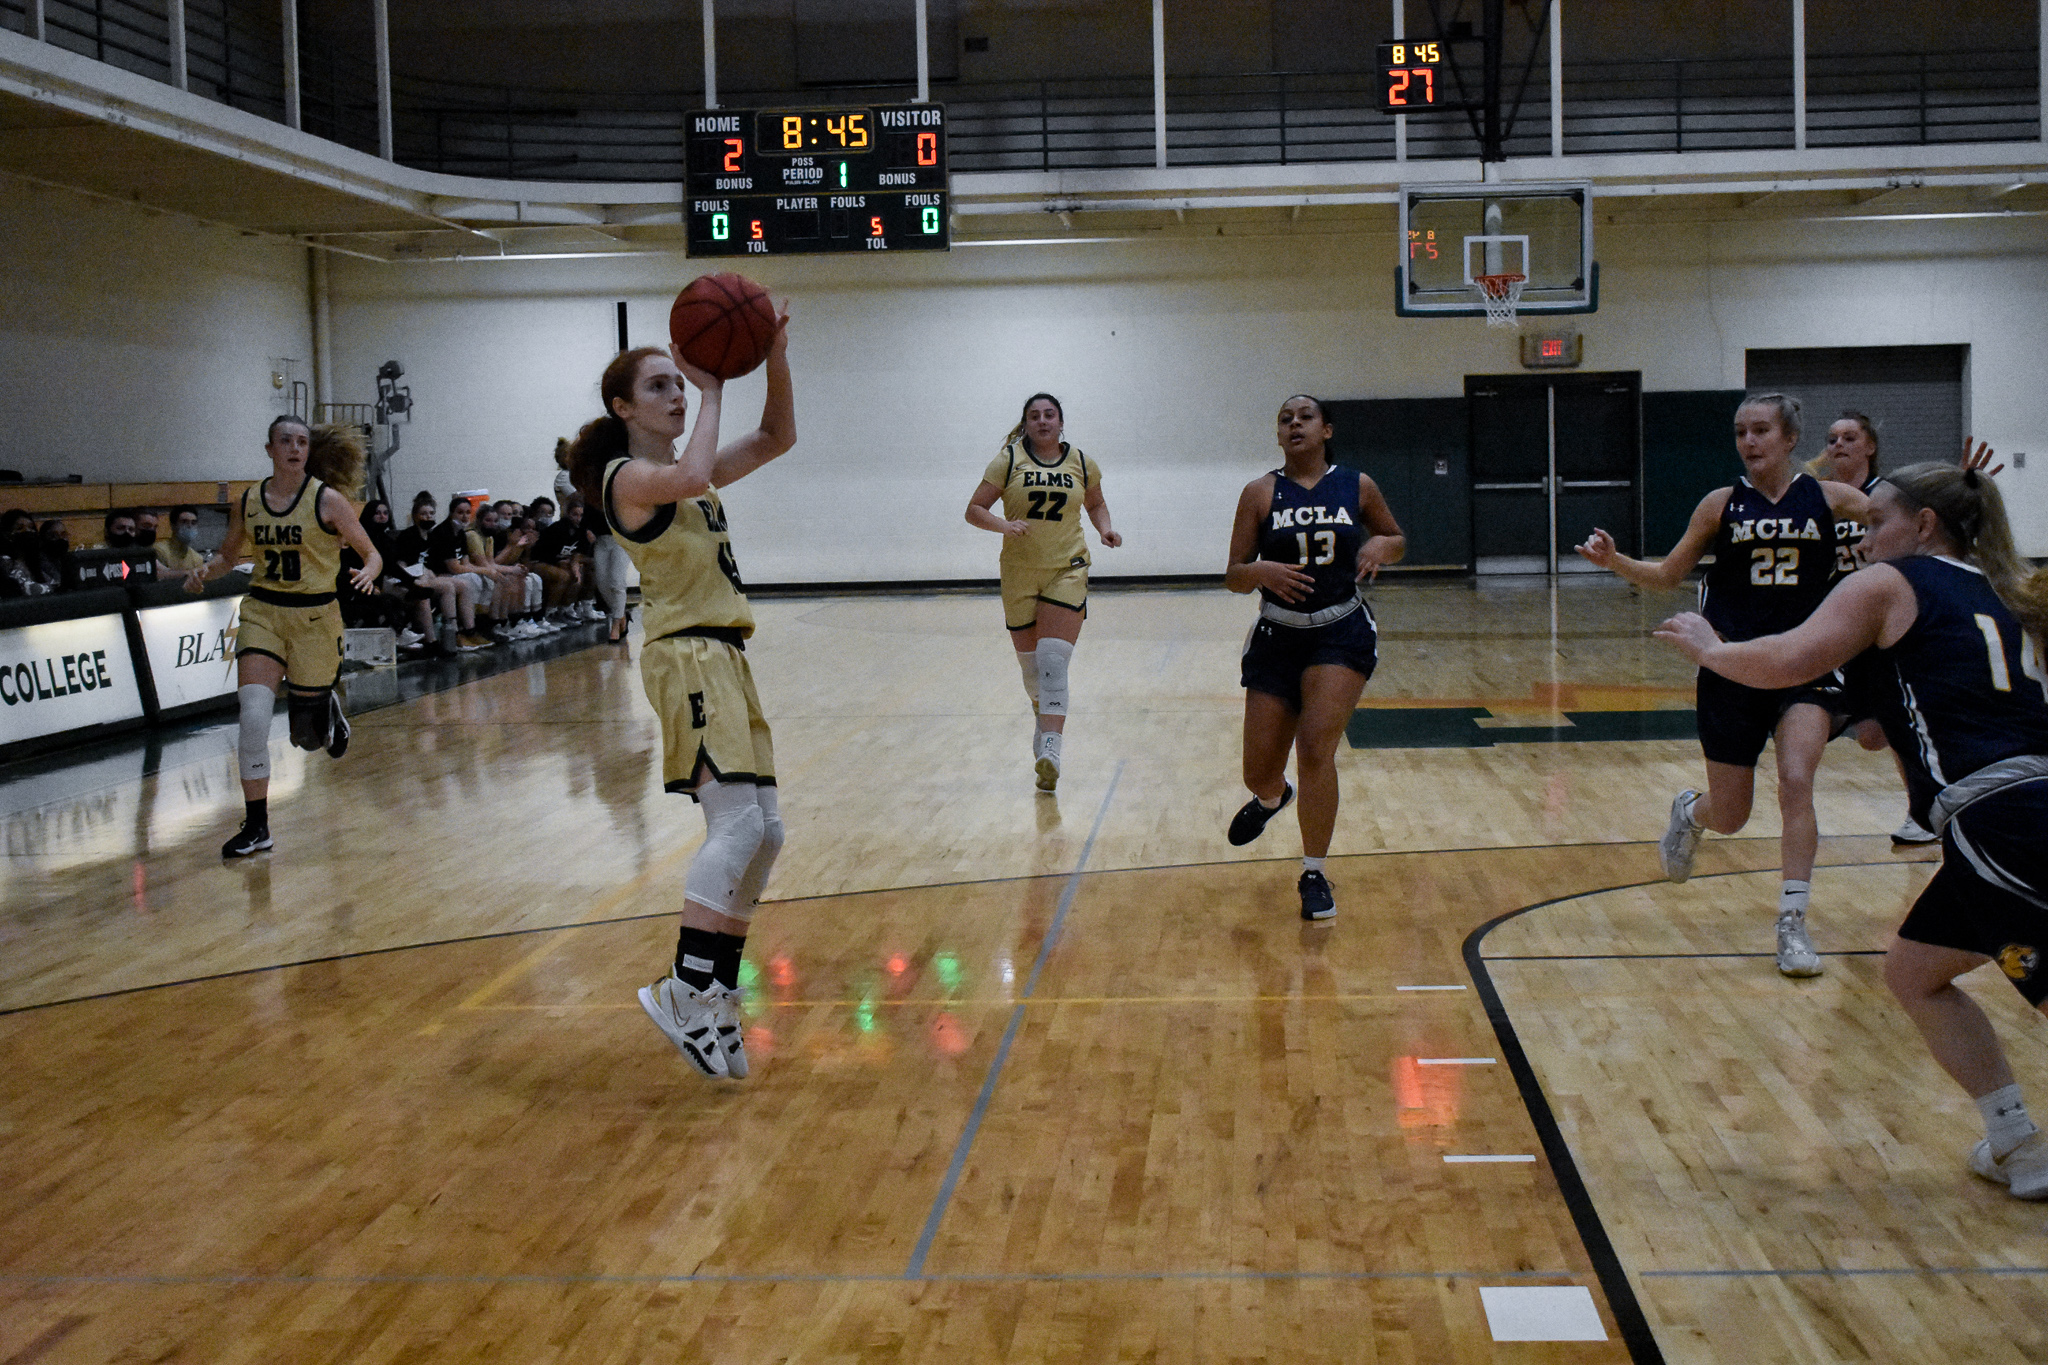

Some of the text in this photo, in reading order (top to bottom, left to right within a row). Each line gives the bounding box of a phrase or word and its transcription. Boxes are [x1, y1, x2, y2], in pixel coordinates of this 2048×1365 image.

[1393, 43, 1440, 64] 8 45
[1388, 68, 1433, 105] 27
[695, 116, 740, 132] HOME
[881, 110, 942, 127] VISITOR
[782, 114, 868, 149] 8:45
[723, 138, 743, 171] 2
[917, 133, 936, 166] 0
[791, 156, 814, 167] POSS
[782, 167, 824, 180] PERIOD
[839, 161, 847, 188] 1
[878, 173, 916, 185] BONUS
[716, 178, 753, 190] BONUS
[694, 200, 730, 212] FOULS
[776, 196, 866, 210] PLAYER FOULS
[905, 194, 941, 206] FOULS
[712, 213, 728, 240] 0
[751, 220, 763, 239] 5
[871, 216, 883, 236] 5
[922, 207, 939, 234] 0
[746, 241, 768, 253] TOL
[865, 238, 888, 250] TOL
[1542, 340, 1563, 356] EXIT
[1023, 470, 1074, 489] ELMS
[1026, 491, 1069, 522] 22
[1272, 506, 1354, 531] MCLA
[254, 525, 303, 545] ELMS
[1729, 518, 1821, 543] MCLA
[1835, 521, 1866, 539] CL
[1296, 530, 1336, 566] 13
[264, 549, 302, 581] 20
[1750, 547, 1800, 586] 22
[0, 650, 112, 706] COLLEGE
